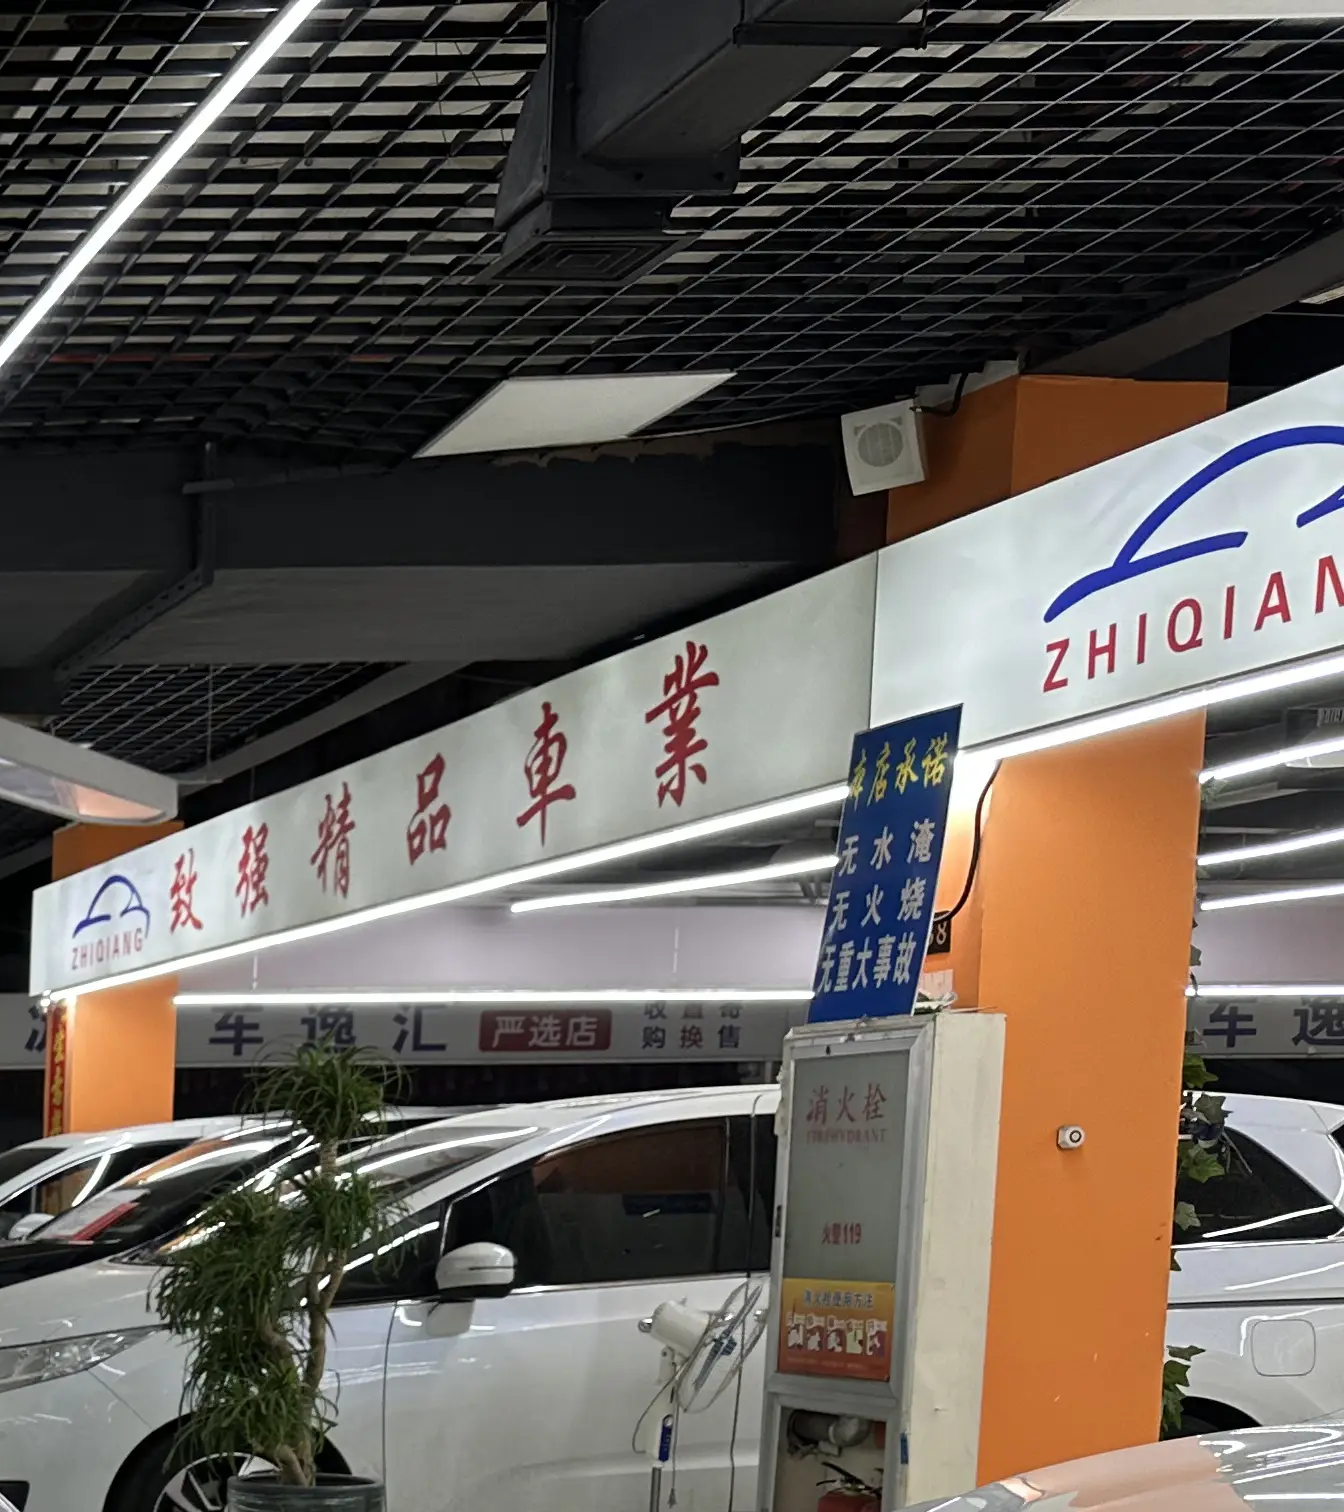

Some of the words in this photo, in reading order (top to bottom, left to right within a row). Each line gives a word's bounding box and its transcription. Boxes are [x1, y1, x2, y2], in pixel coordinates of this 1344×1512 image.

[850, 732, 948, 811] 本店承诺
[838, 817, 936, 878] 无水淹
[828, 876, 926, 932] 无火烧
[71, 927, 143, 971] ZHIQIANG
[817, 931, 917, 993] 无重大事故
[492, 1015, 598, 1048] 严选店
[806, 1083, 887, 1124] 消火栓
[822, 1222, 862, 1245] 火警119
